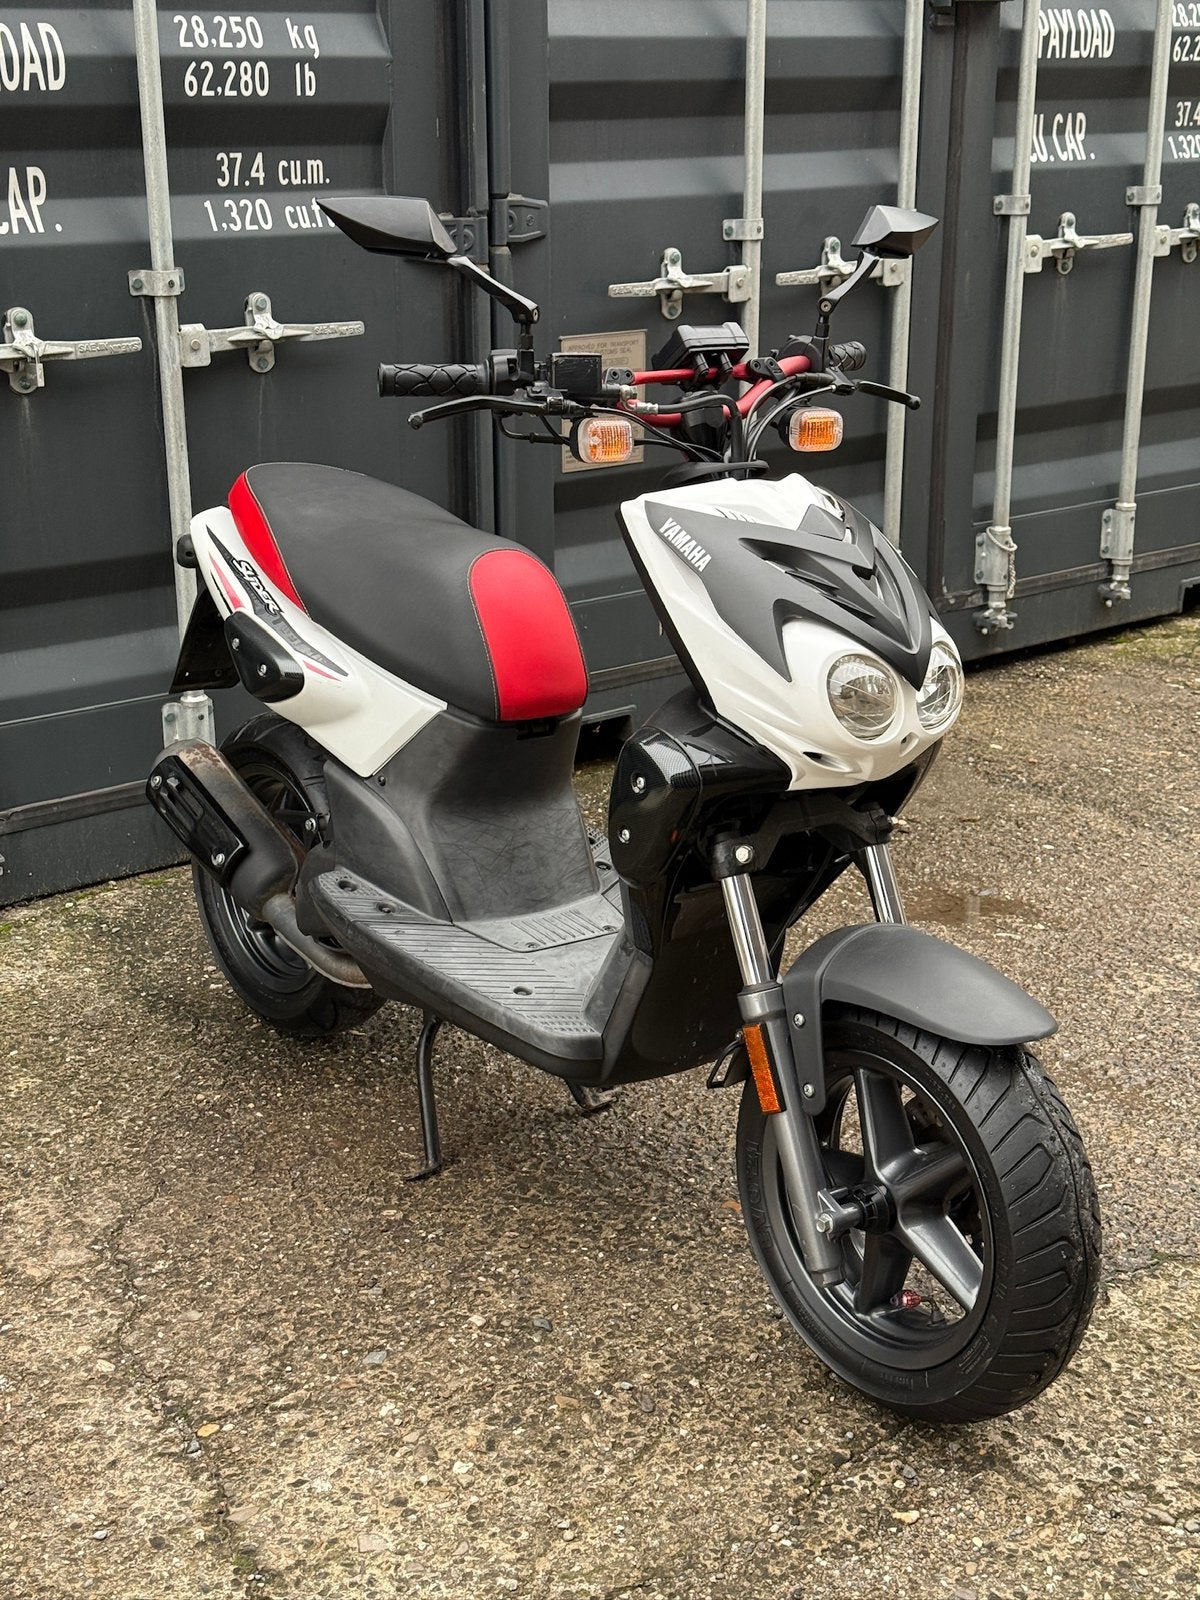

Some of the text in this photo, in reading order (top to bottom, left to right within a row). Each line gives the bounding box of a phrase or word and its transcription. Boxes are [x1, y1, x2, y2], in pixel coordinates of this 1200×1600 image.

[0, 22, 66, 92] OAD
[173, 15, 320, 59] 28,250 kg
[1038, 8, 1115, 59] PAYLOAD
[184, 61, 316, 97] 62,280 lb
[1030, 112, 1095, 162] U.CAP.
[216, 152, 330, 187] 37.4 cu.m.
[0, 166, 62, 235] AP.
[204, 198, 273, 231] 1,320
[658, 517, 712, 572] YAMAHA
